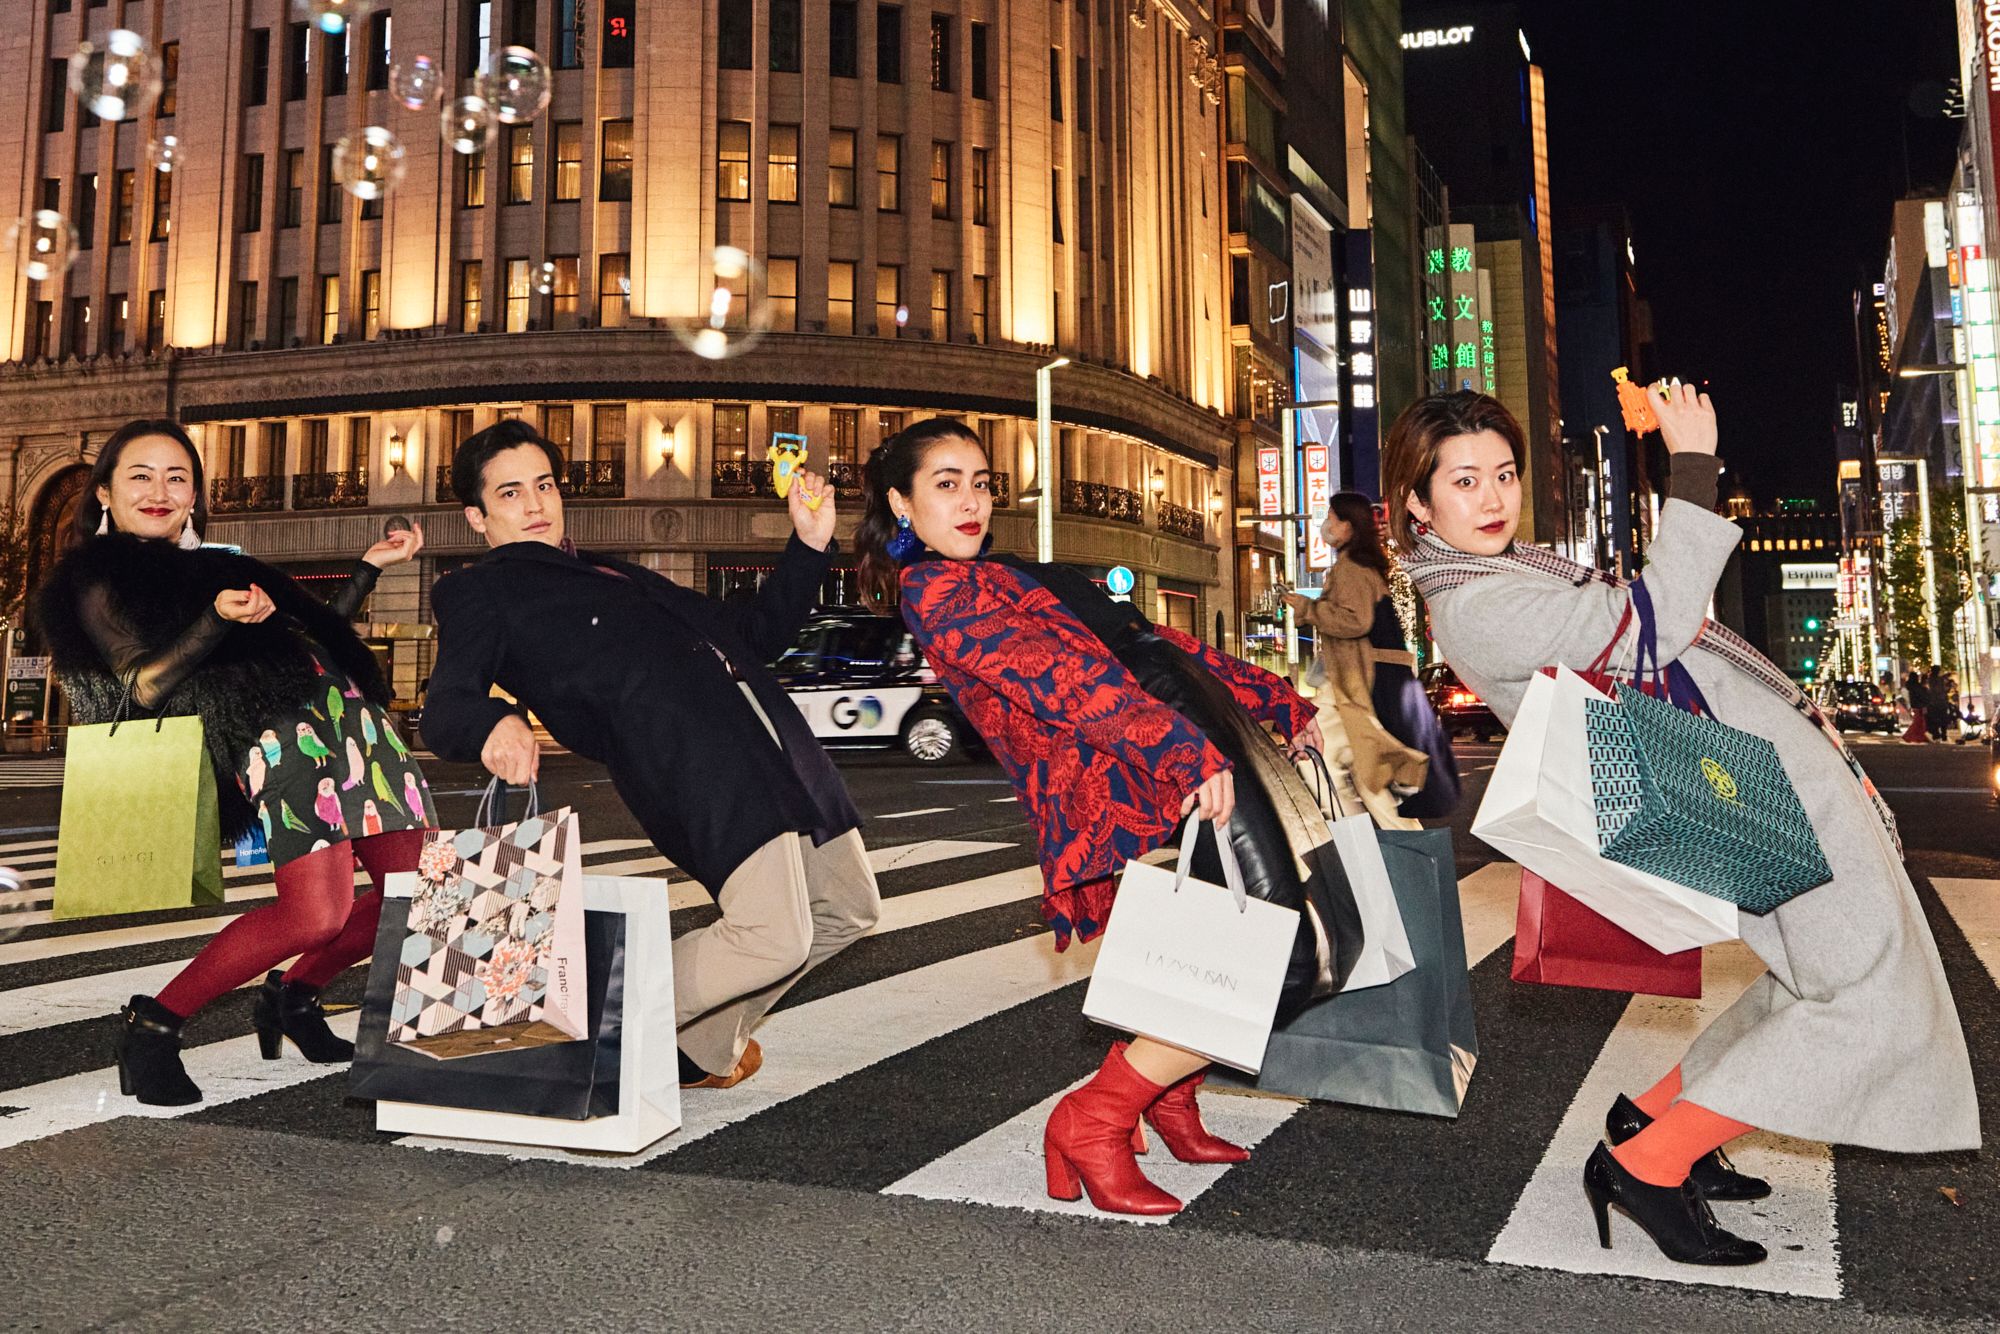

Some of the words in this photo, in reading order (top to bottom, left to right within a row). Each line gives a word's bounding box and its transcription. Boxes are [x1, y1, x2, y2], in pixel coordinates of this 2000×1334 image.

[1399, 26, 1474, 49] HUBLOT
[1451, 247, 1476, 369] 教文館
[1481, 321, 1495, 391] 教文館ビル
[1788, 570, 1833, 579] Brillia
[831, 696, 883, 730] GO
